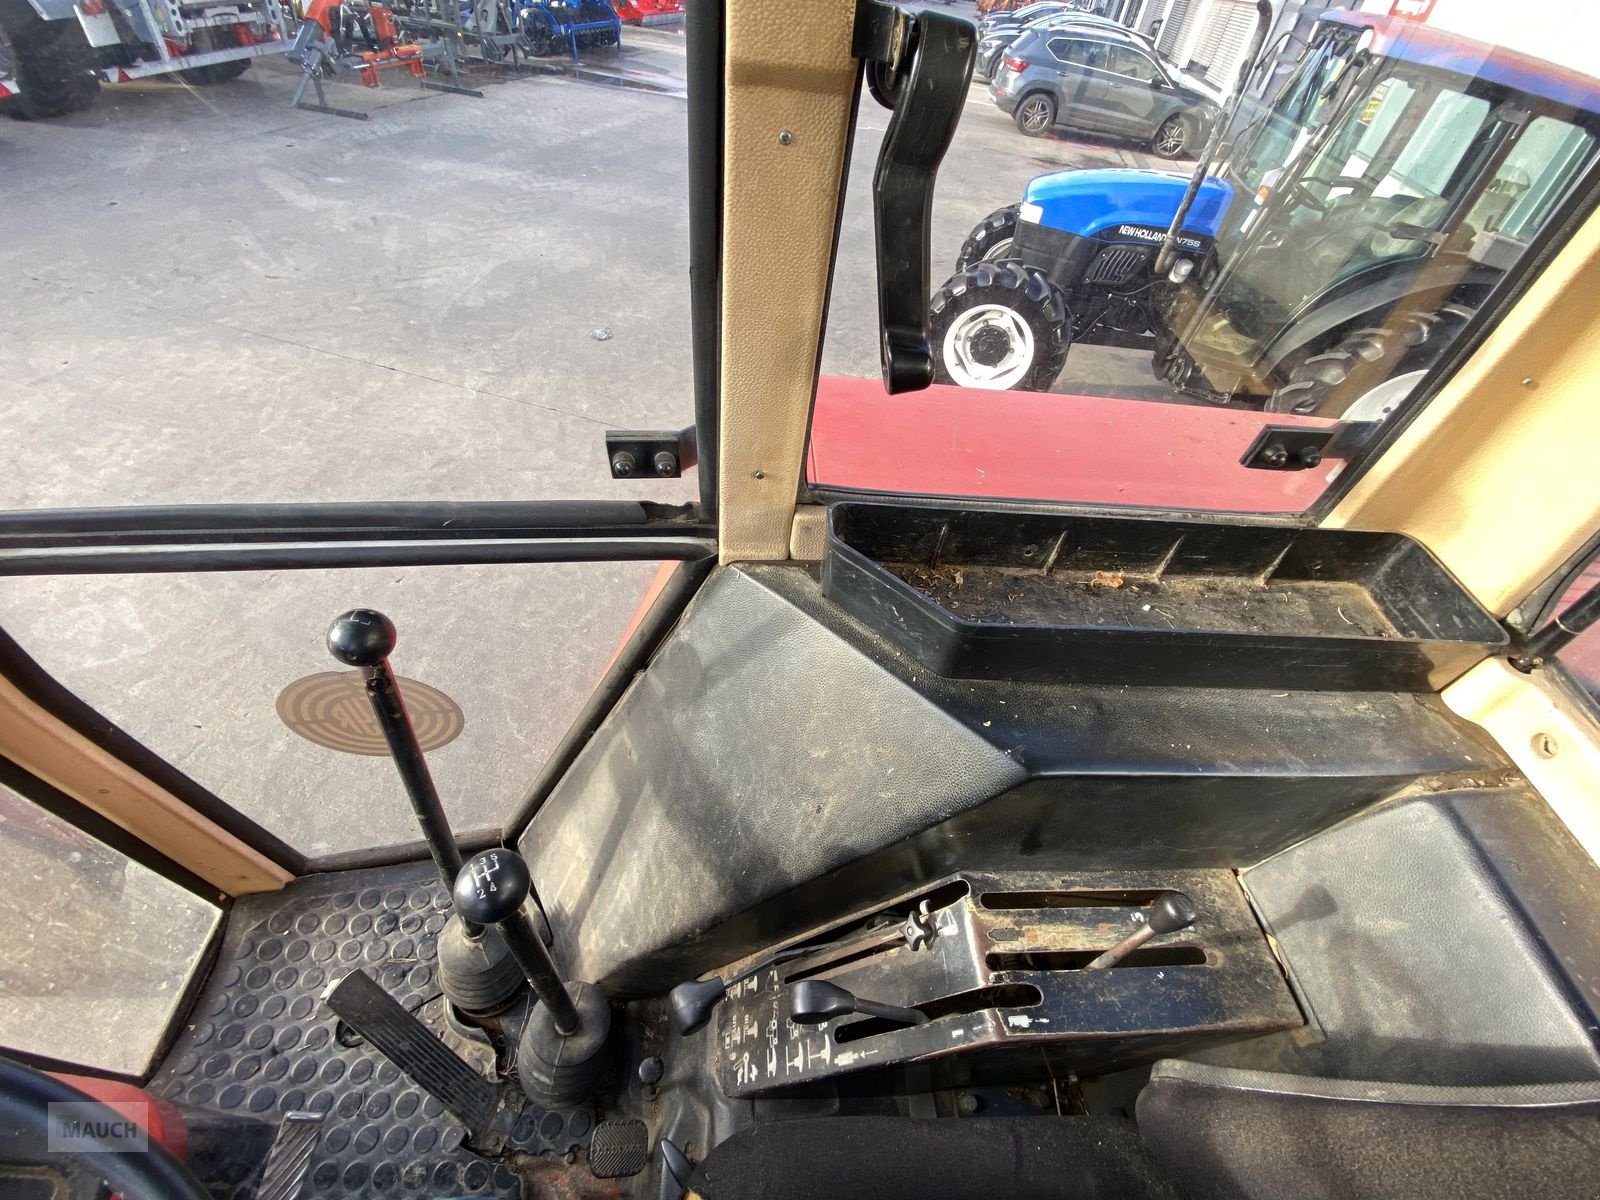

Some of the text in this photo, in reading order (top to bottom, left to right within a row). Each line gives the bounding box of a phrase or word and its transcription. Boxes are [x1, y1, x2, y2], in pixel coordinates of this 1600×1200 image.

[1119, 225, 1167, 241] NEW HOLLAND
[1176, 237, 1200, 248] N75S
[479, 857, 486, 865] 3
[490, 882, 497, 892] 4
[476, 889, 486, 900] 2
